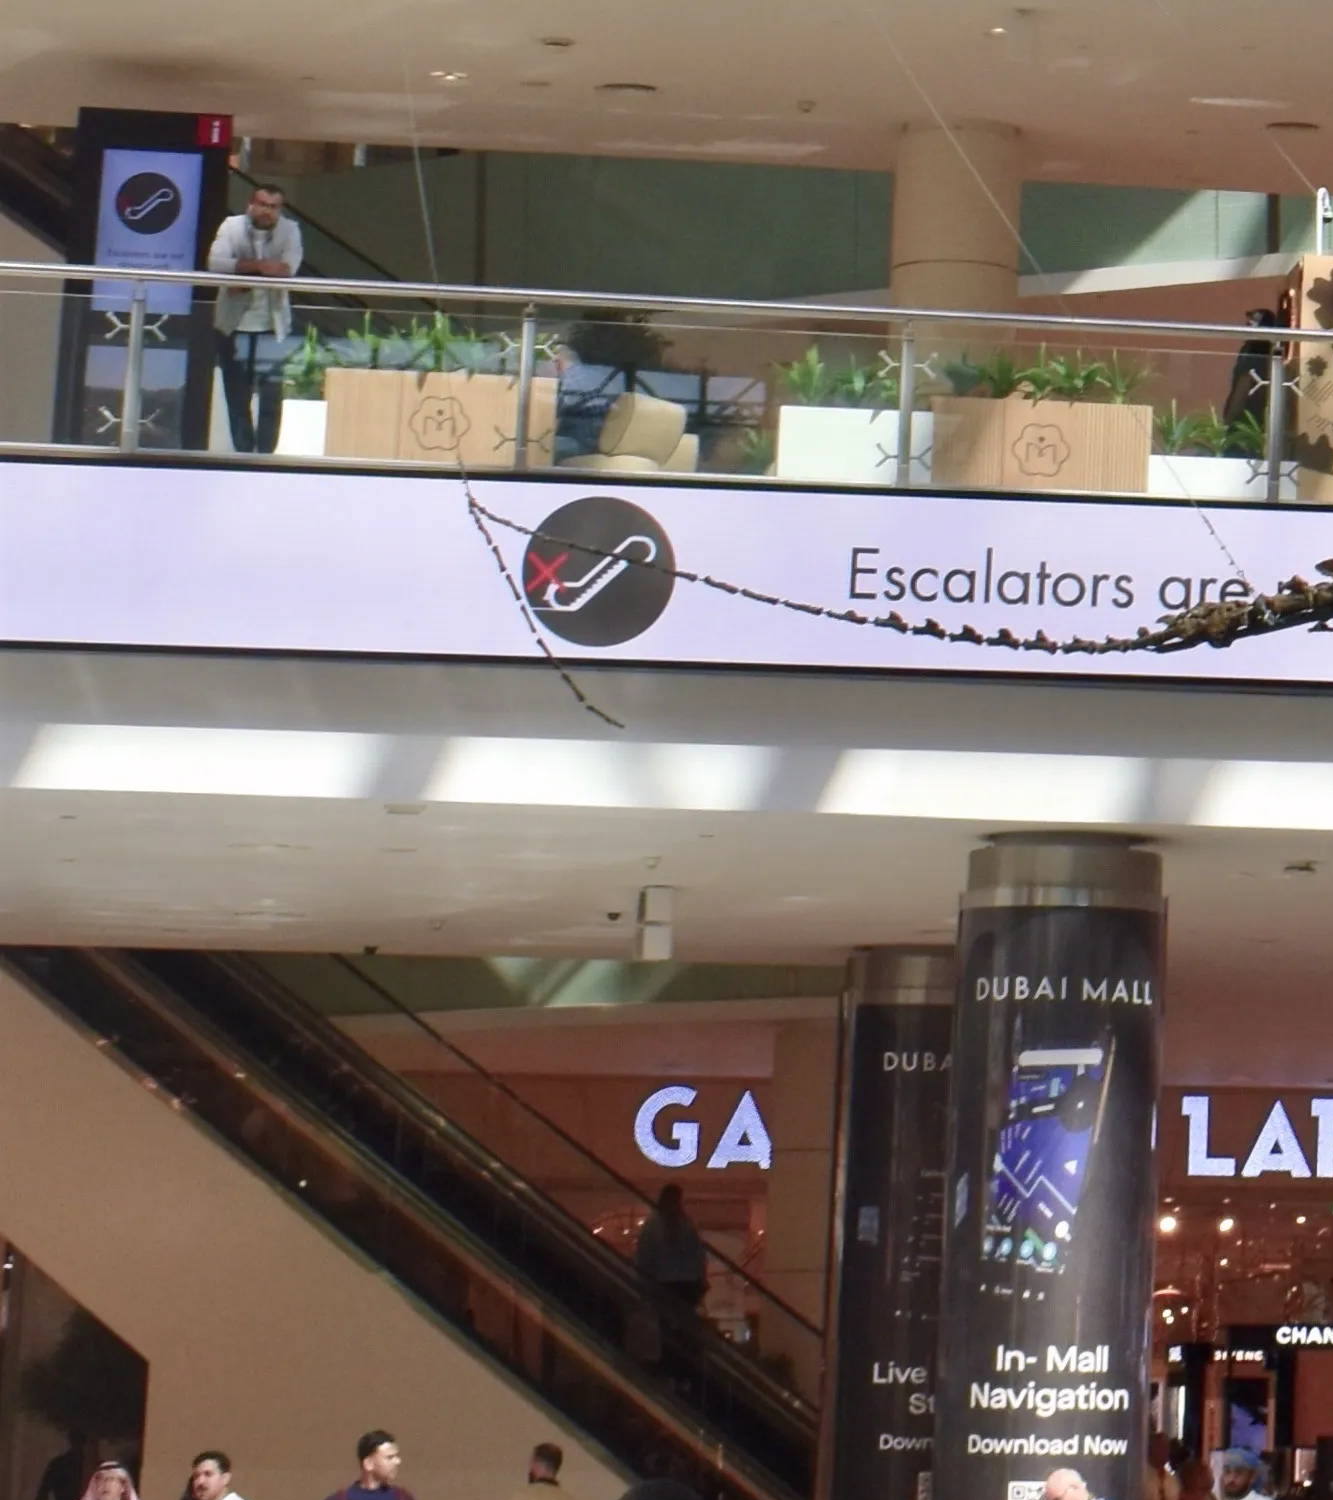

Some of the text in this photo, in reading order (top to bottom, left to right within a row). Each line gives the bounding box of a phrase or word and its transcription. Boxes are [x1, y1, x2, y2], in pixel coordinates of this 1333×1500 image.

[848, 546, 1135, 609] Escalators
[975, 975, 1154, 1006] DUBAI MALL
[634, 1085, 773, 1170] GA
[872, 1361, 927, 1384] Live
[1046, 1344, 1110, 1373] Mall
[969, 1380, 1130, 1417] Navigation
[967, 1433, 1128, 1456] Download Now
